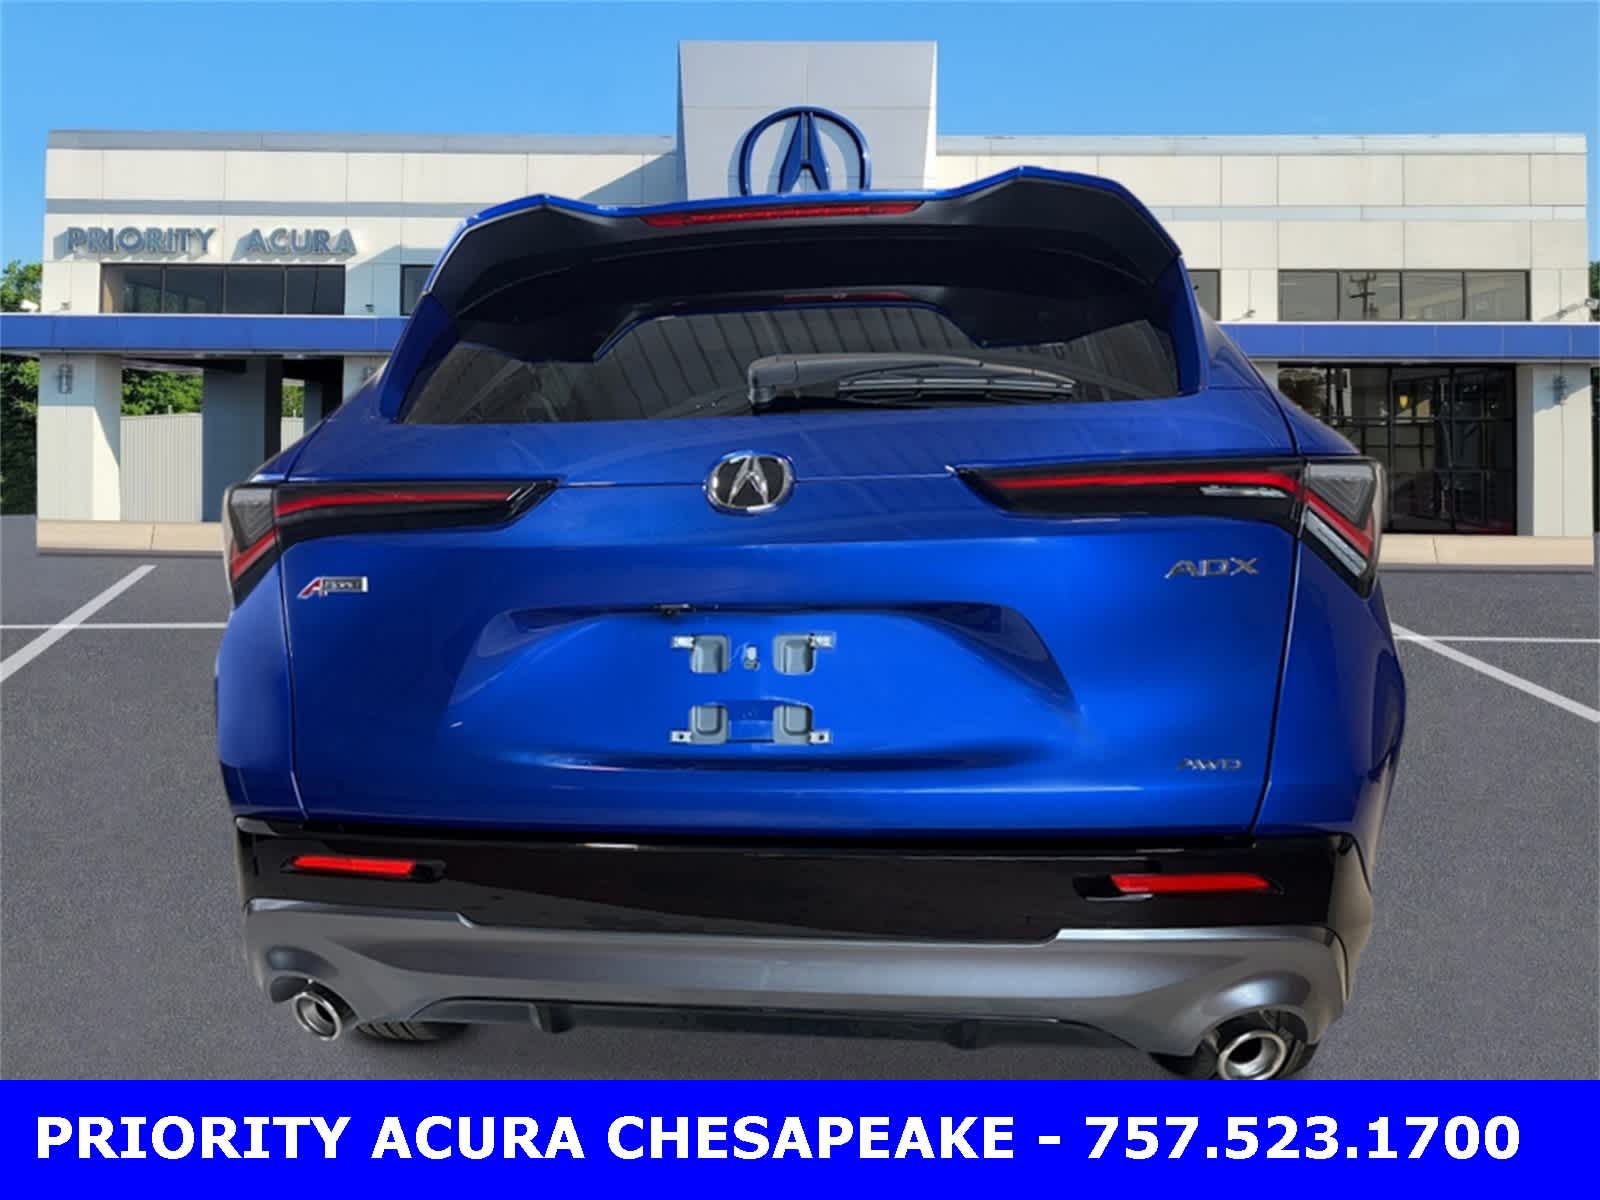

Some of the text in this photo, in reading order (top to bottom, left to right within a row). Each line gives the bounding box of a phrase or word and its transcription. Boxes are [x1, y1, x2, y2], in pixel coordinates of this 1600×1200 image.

[66, 226, 357, 255] PRIORITY ACURA
[1164, 556, 1259, 580] ADX
[1176, 757, 1243, 771] AWD
